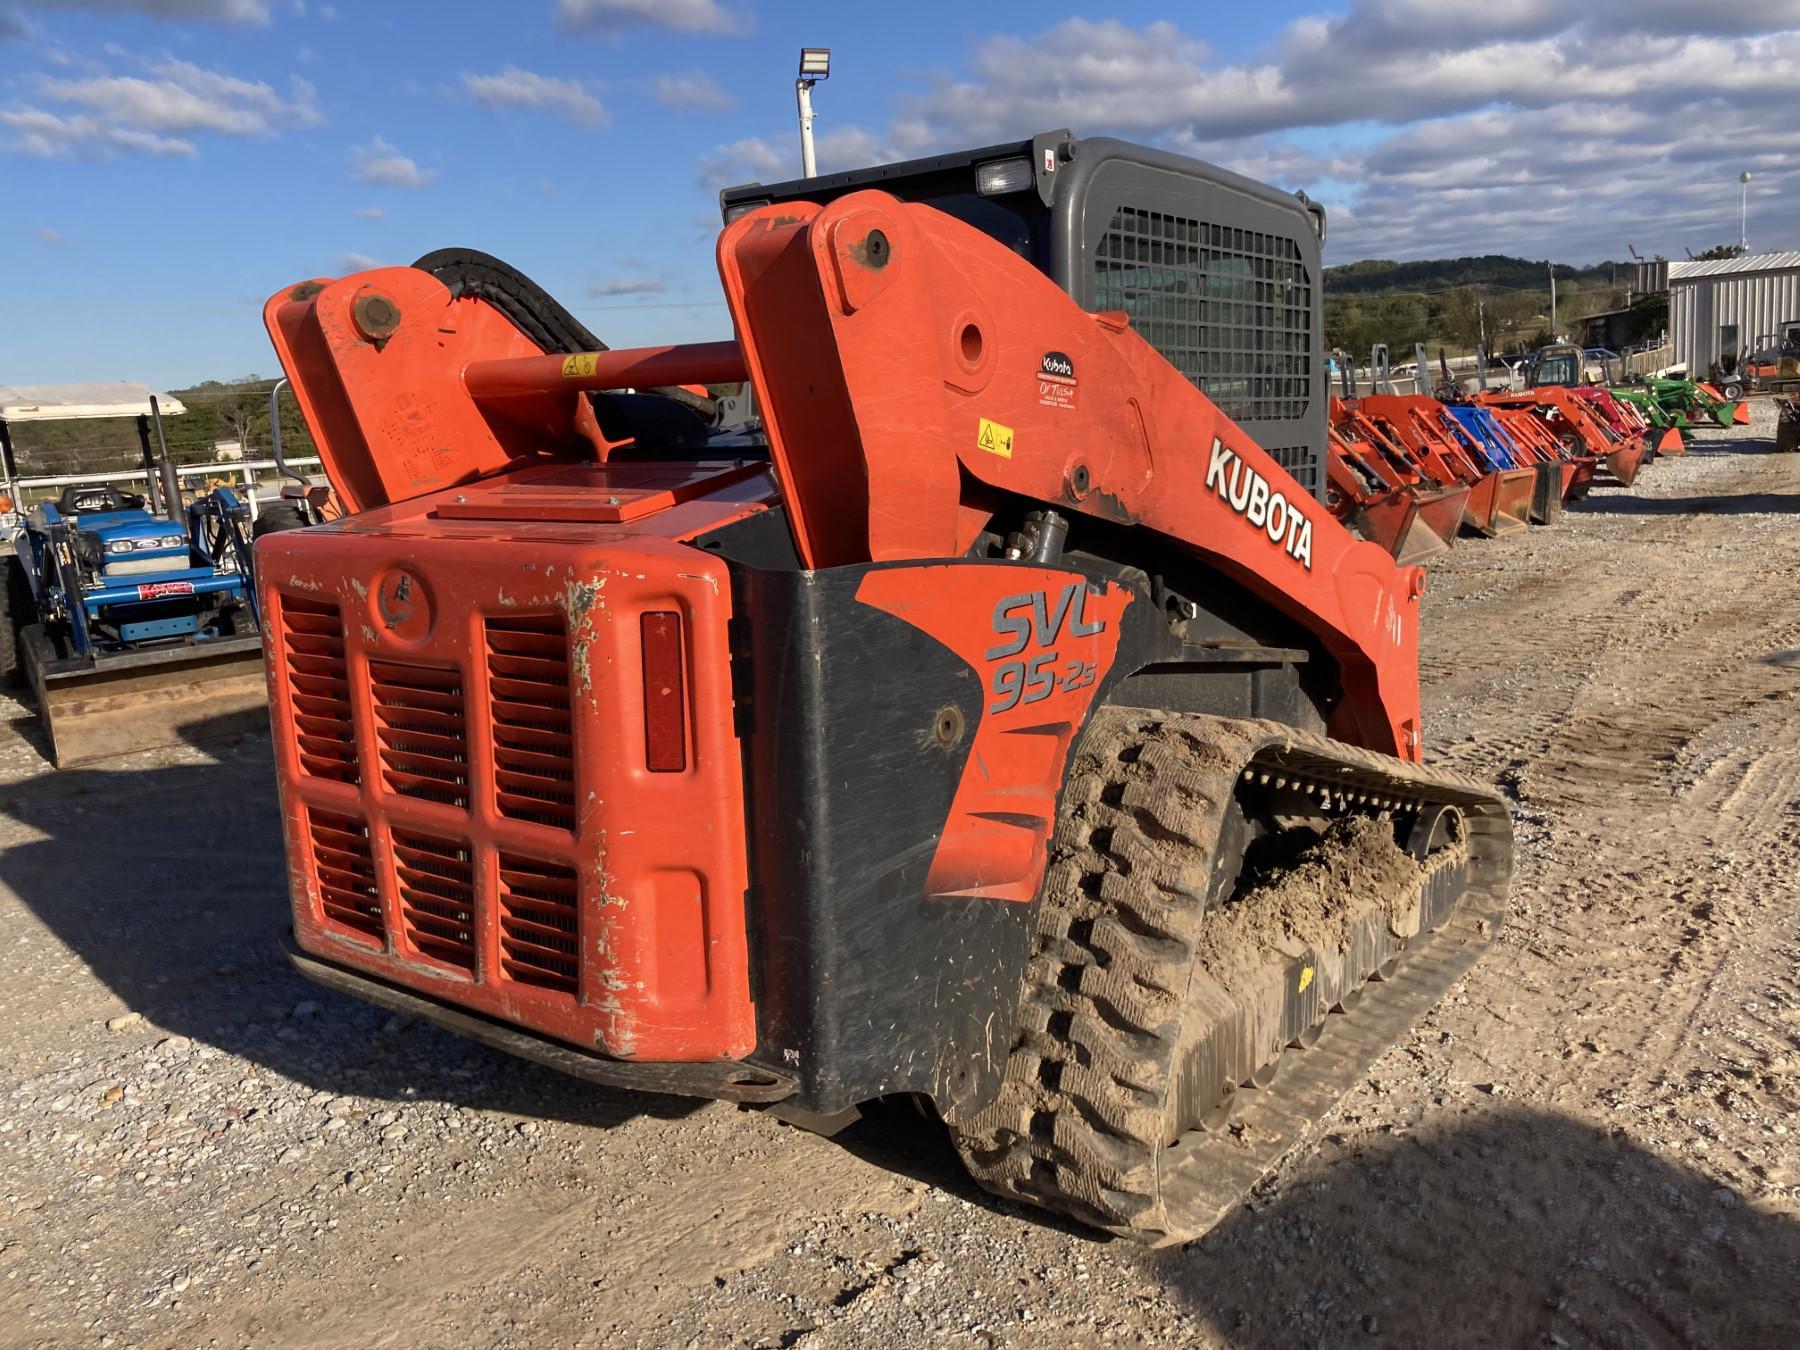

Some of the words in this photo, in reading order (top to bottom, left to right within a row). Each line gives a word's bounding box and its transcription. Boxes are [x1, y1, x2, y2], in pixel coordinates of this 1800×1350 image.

[1043, 357, 1072, 375] Kubota
[1205, 436, 1313, 570] KUBOTA
[985, 583, 1105, 661] SVL
[990, 652, 1097, 715] 95-25
